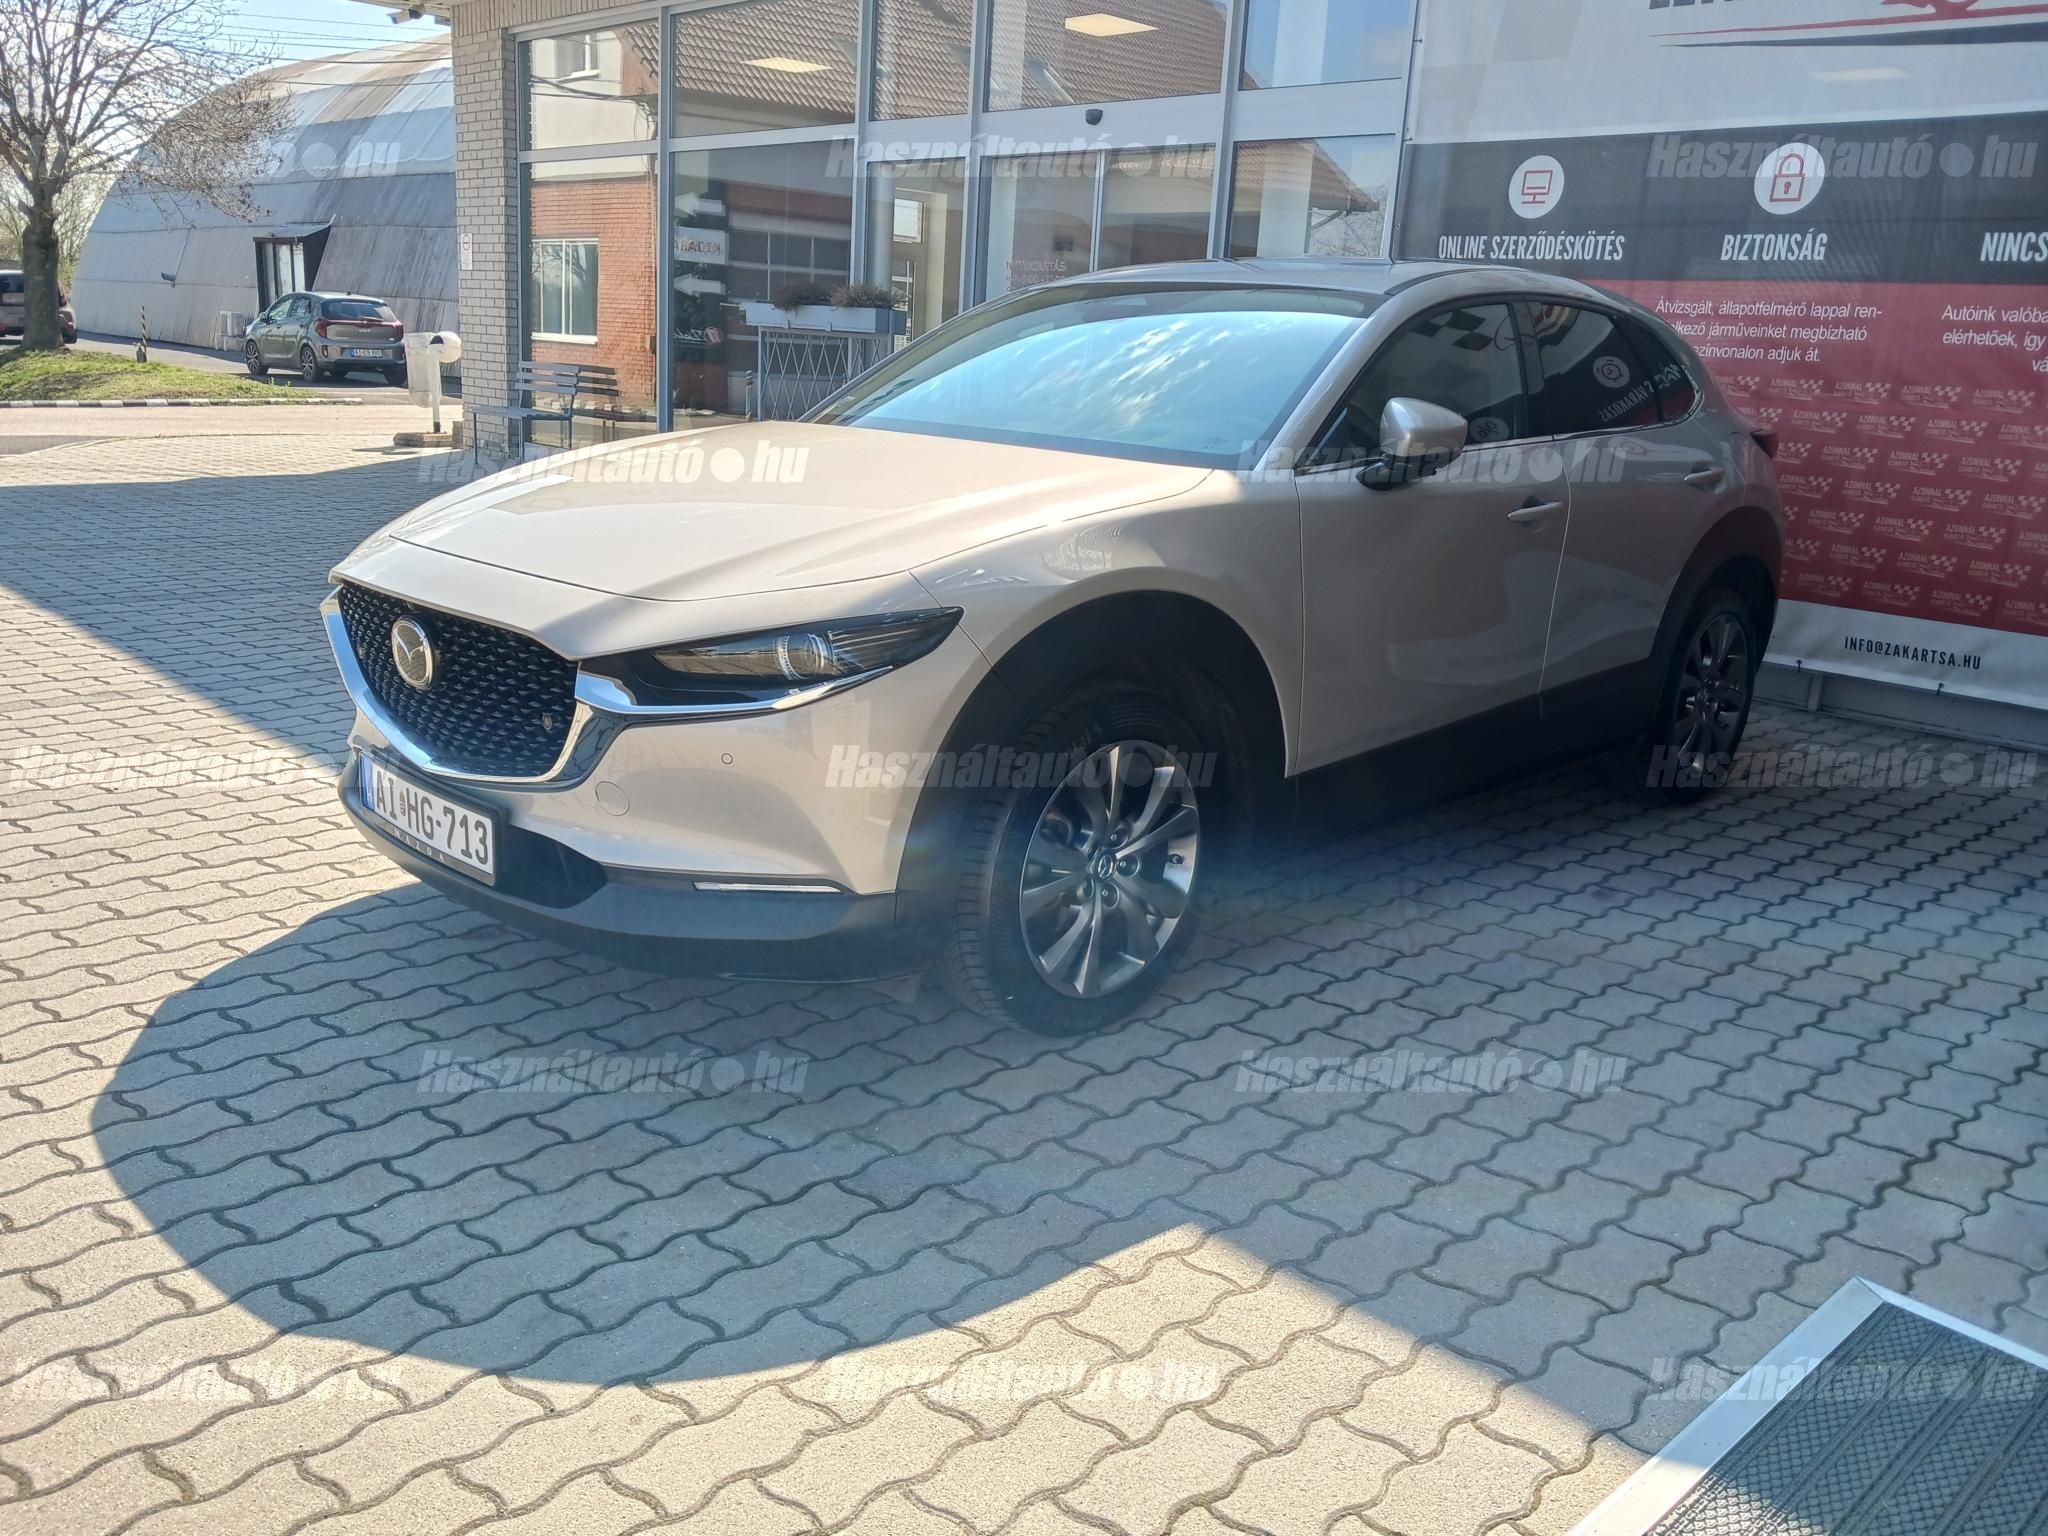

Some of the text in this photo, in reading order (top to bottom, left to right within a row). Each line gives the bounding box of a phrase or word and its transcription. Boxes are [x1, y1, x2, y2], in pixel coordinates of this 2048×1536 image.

[1438, 230, 1625, 261] ONLINE SZERZŐDÉSKÖTÉS
[1720, 228, 1828, 262] BIZTONSÁG
[1980, 231, 2048, 262] NINCS
[1655, 296, 1882, 321] Átvizsgált, állapotfelmérő lappal ren-
[1941, 304, 1996, 321] Autóink
[1671, 321, 1867, 343] lkező járműveinket megbízható
[1942, 328, 2046, 351] elérhetőek, így
[1767, 347, 1801, 364] adjuk
[1804, 350, 1821, 362] át.
[1844, 636, 1982, 670] INFO@ZAKARTSA.HU
